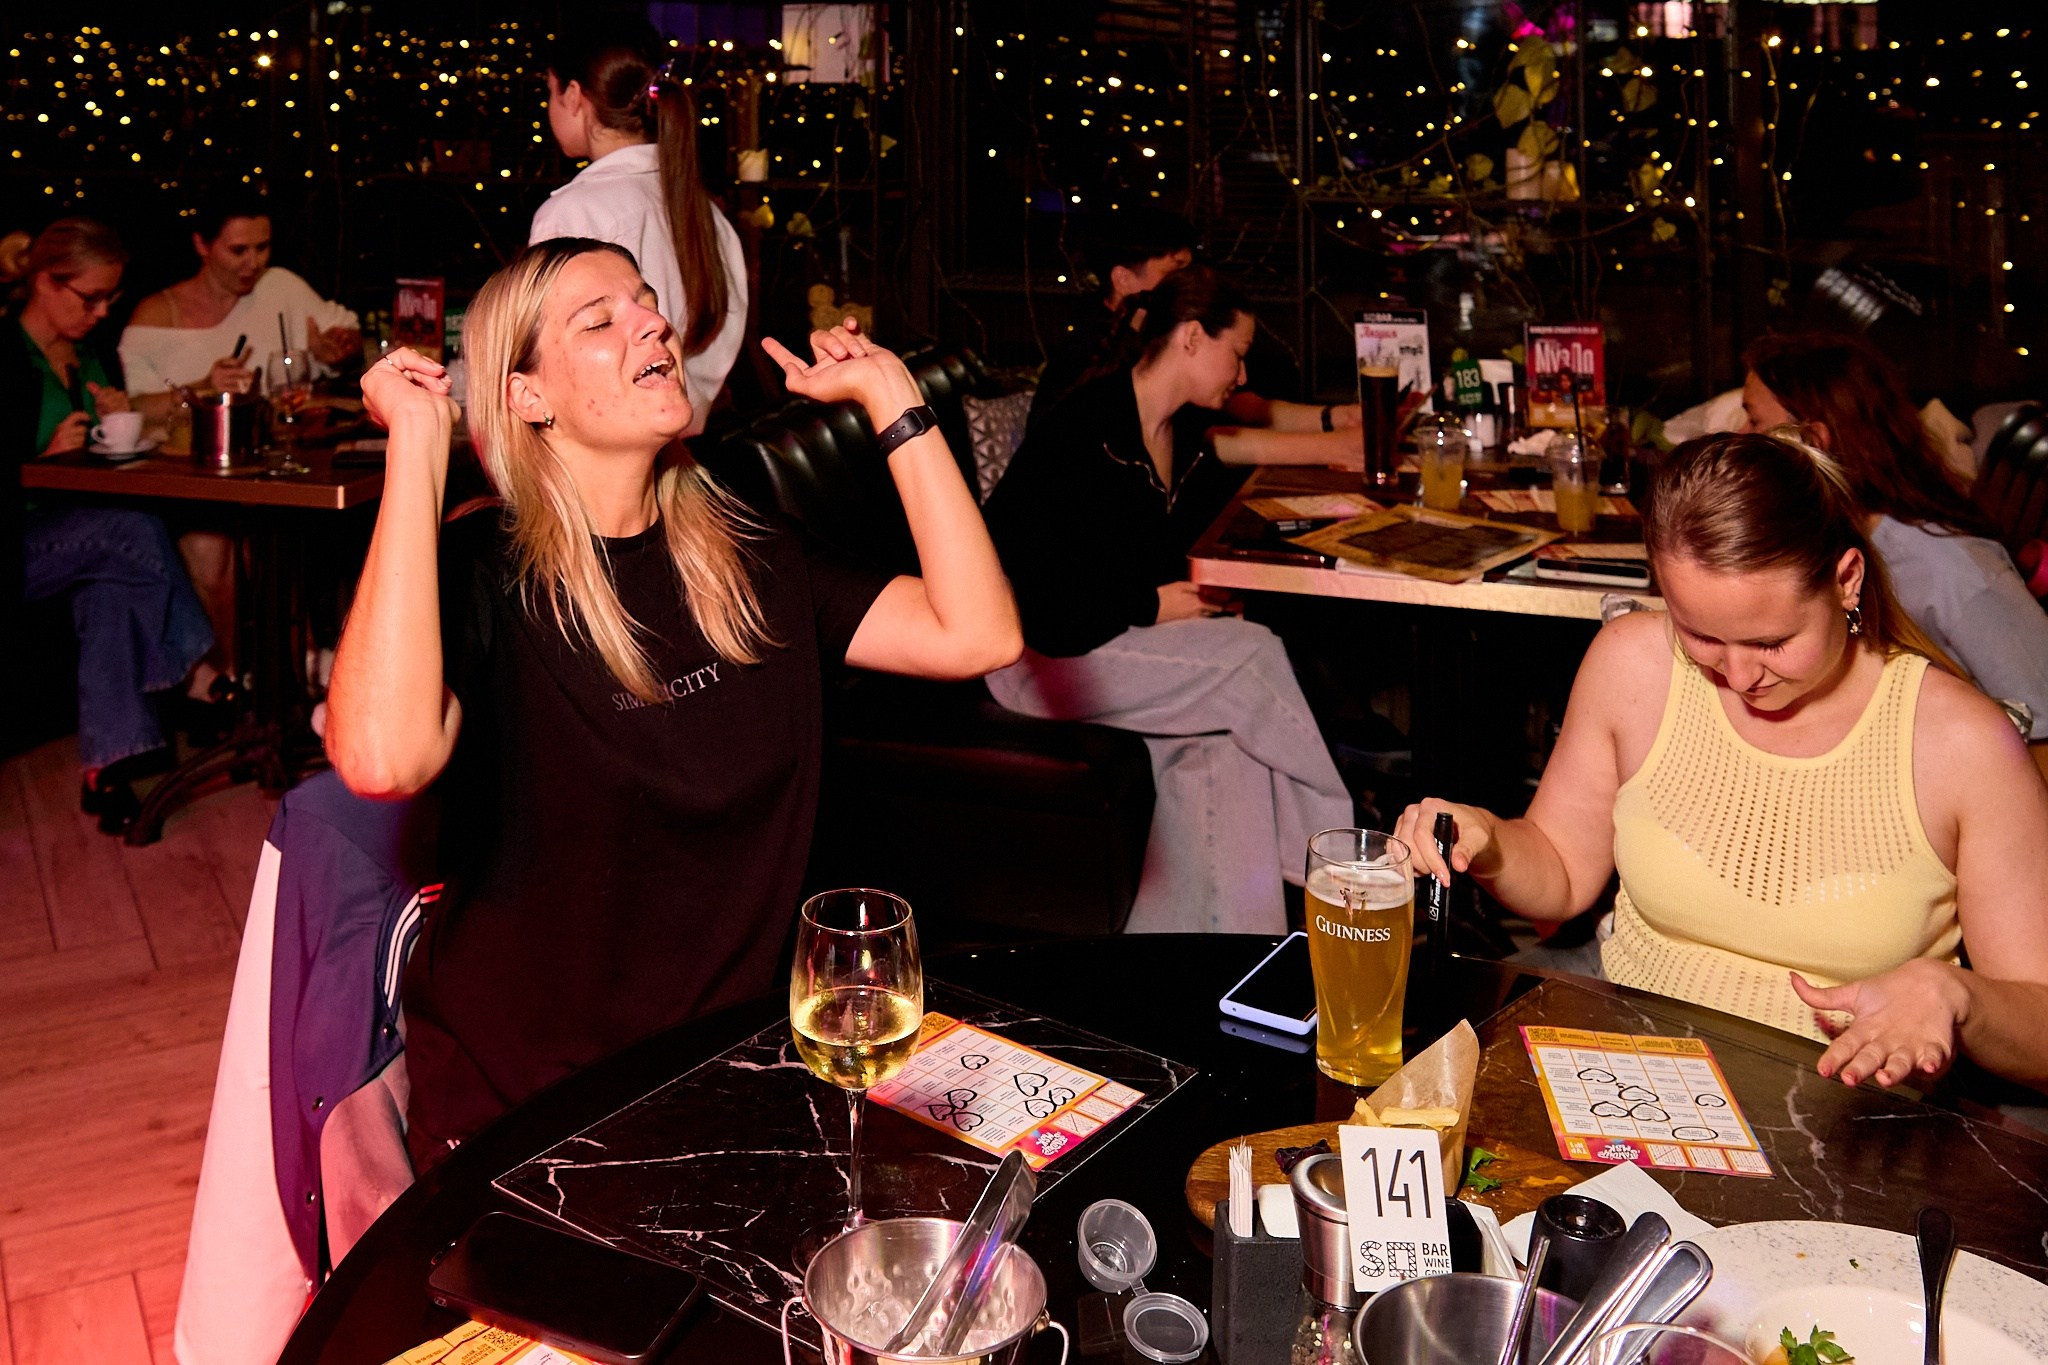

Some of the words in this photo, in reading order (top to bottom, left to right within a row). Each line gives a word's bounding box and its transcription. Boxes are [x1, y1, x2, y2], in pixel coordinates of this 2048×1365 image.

[1456, 367, 1481, 389] 183
[612, 662, 721, 711] SIMICITY
[1315, 914, 1391, 942] GUINNESS
[1361, 1147, 1431, 1218] 141
[1422, 1243, 1449, 1257] BAR
[1424, 1257, 1450, 1269] WINE
